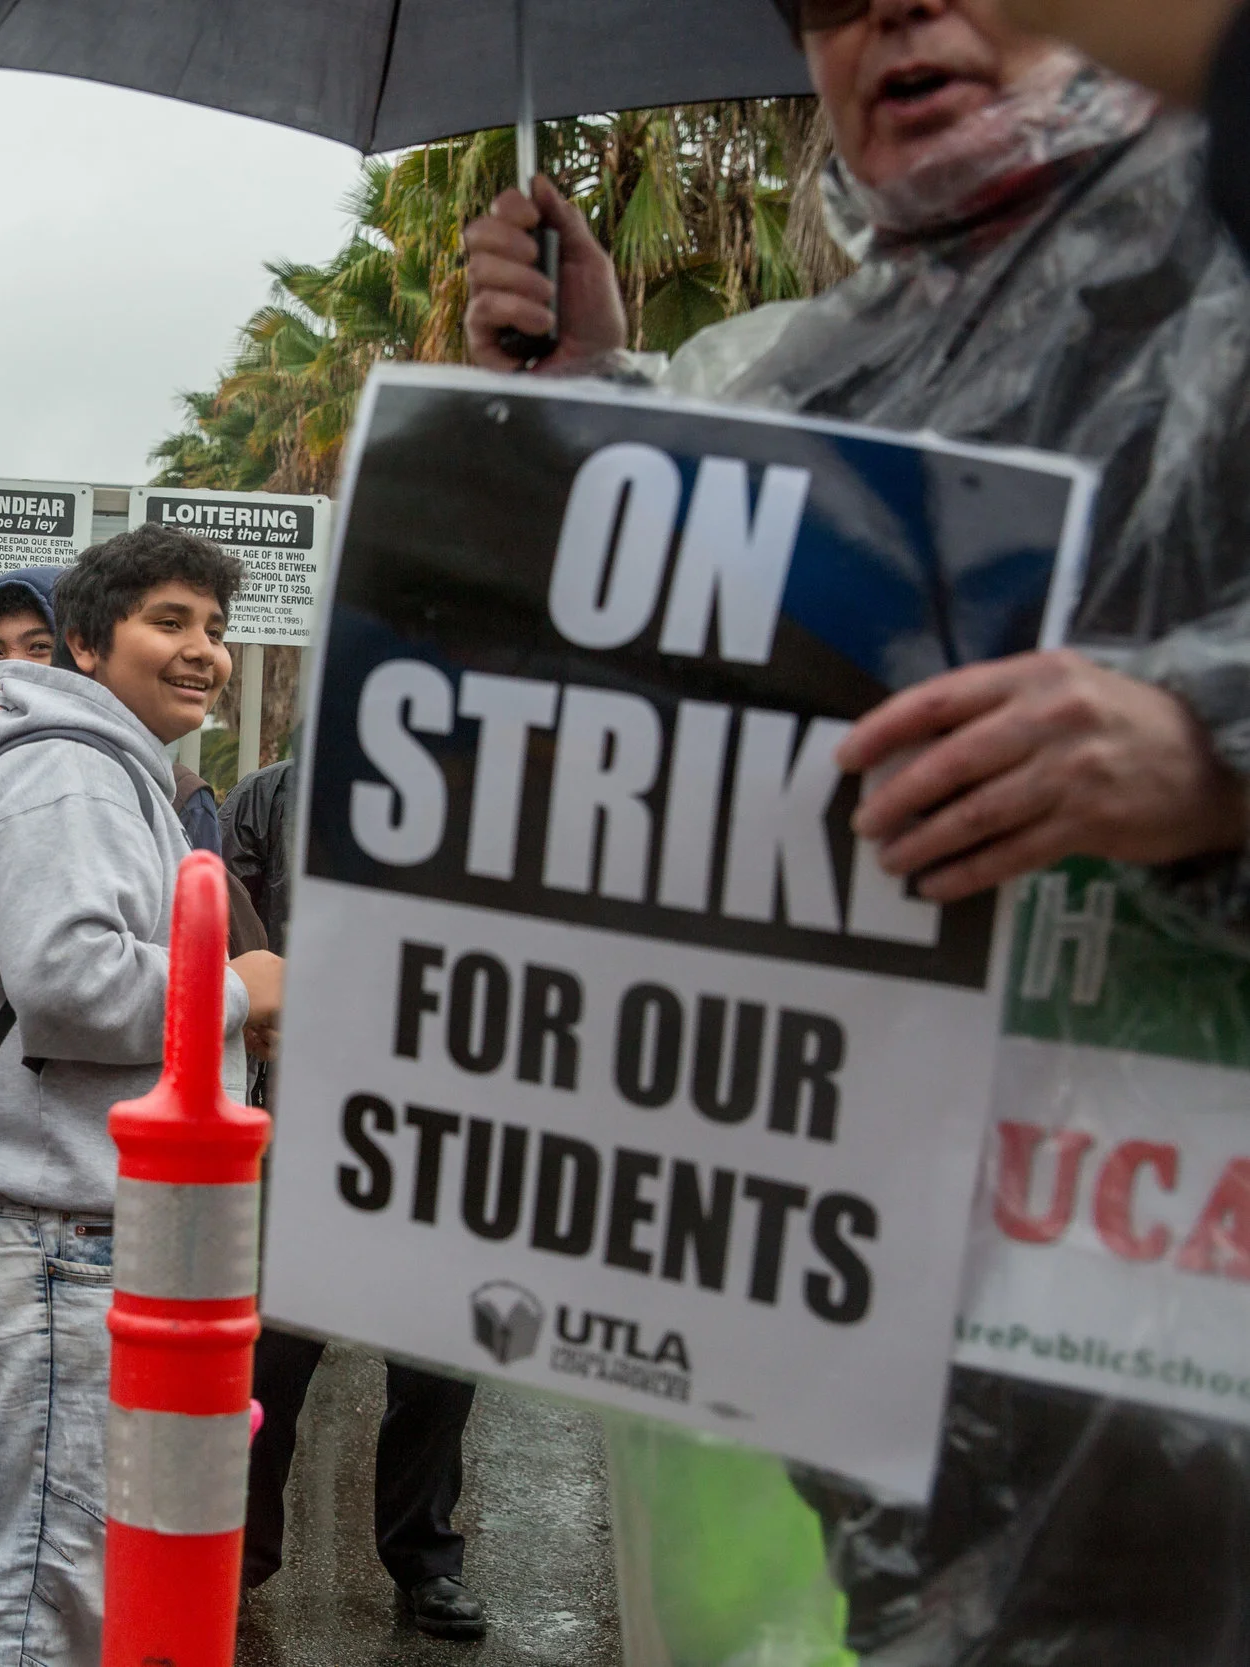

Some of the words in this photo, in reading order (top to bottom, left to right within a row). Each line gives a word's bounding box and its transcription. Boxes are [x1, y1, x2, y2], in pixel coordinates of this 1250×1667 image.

[162, 504, 297, 529] LOITERING
[17, 517, 30, 529] la
[35, 518, 57, 533] ley
[238, 529, 261, 541] the
[266, 530, 298, 543] law!
[16, 546, 51, 554] PUBLICOS
[226, 549, 240, 557] THE
[243, 550, 258, 558] AGE
[286, 553, 304, 561] WHO
[548, 442, 809, 664] ON
[246, 561, 276, 570] PLACES
[279, 563, 316, 572] BETWEEN
[251, 572, 282, 581] SCHOOL
[285, 574, 305, 583] DAYS
[252, 583, 262, 591] OF
[265, 584, 276, 592] UP
[279, 585, 288, 593] TO
[231, 593, 279, 603] MMUNITY
[281, 595, 314, 605] SERVICE
[394, 940, 582, 1091] FOR
[614, 982, 845, 1143] OUR
[337, 1094, 876, 1326] STUDENTS
[555, 1304, 690, 1371] UTLA
